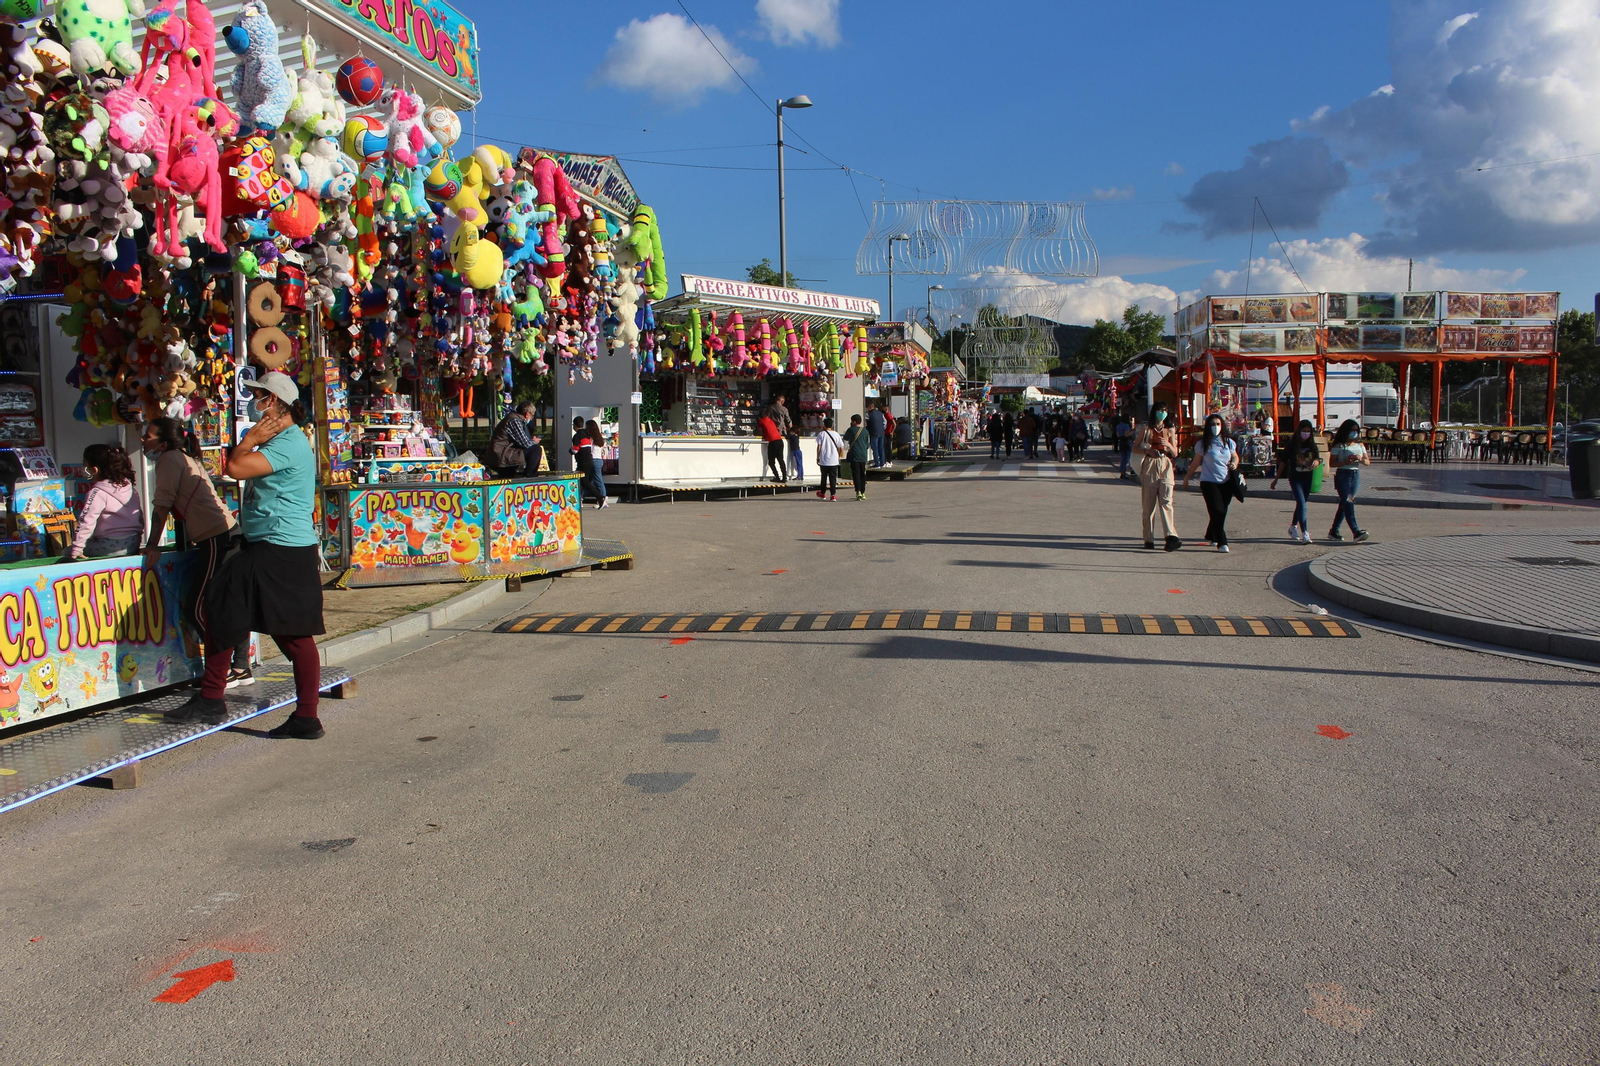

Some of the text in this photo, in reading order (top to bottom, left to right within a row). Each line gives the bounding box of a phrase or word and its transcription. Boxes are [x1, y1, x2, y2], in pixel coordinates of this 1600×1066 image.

[341, 0, 458, 77] ATOS
[695, 278, 873, 313] RECREATIVOS JUAN LUIS
[1480, 336, 1516, 347] Kebab
[22, 449, 42, 458] PATOS
[31, 468, 50, 477] PATOS
[366, 489, 463, 522] PATITOS
[504, 484, 566, 516] PATITOS
[384, 552, 449, 566] MARI CARMEN
[516, 541, 560, 556] MARI CARMEN
[53, 568, 166, 652] PREMIO
